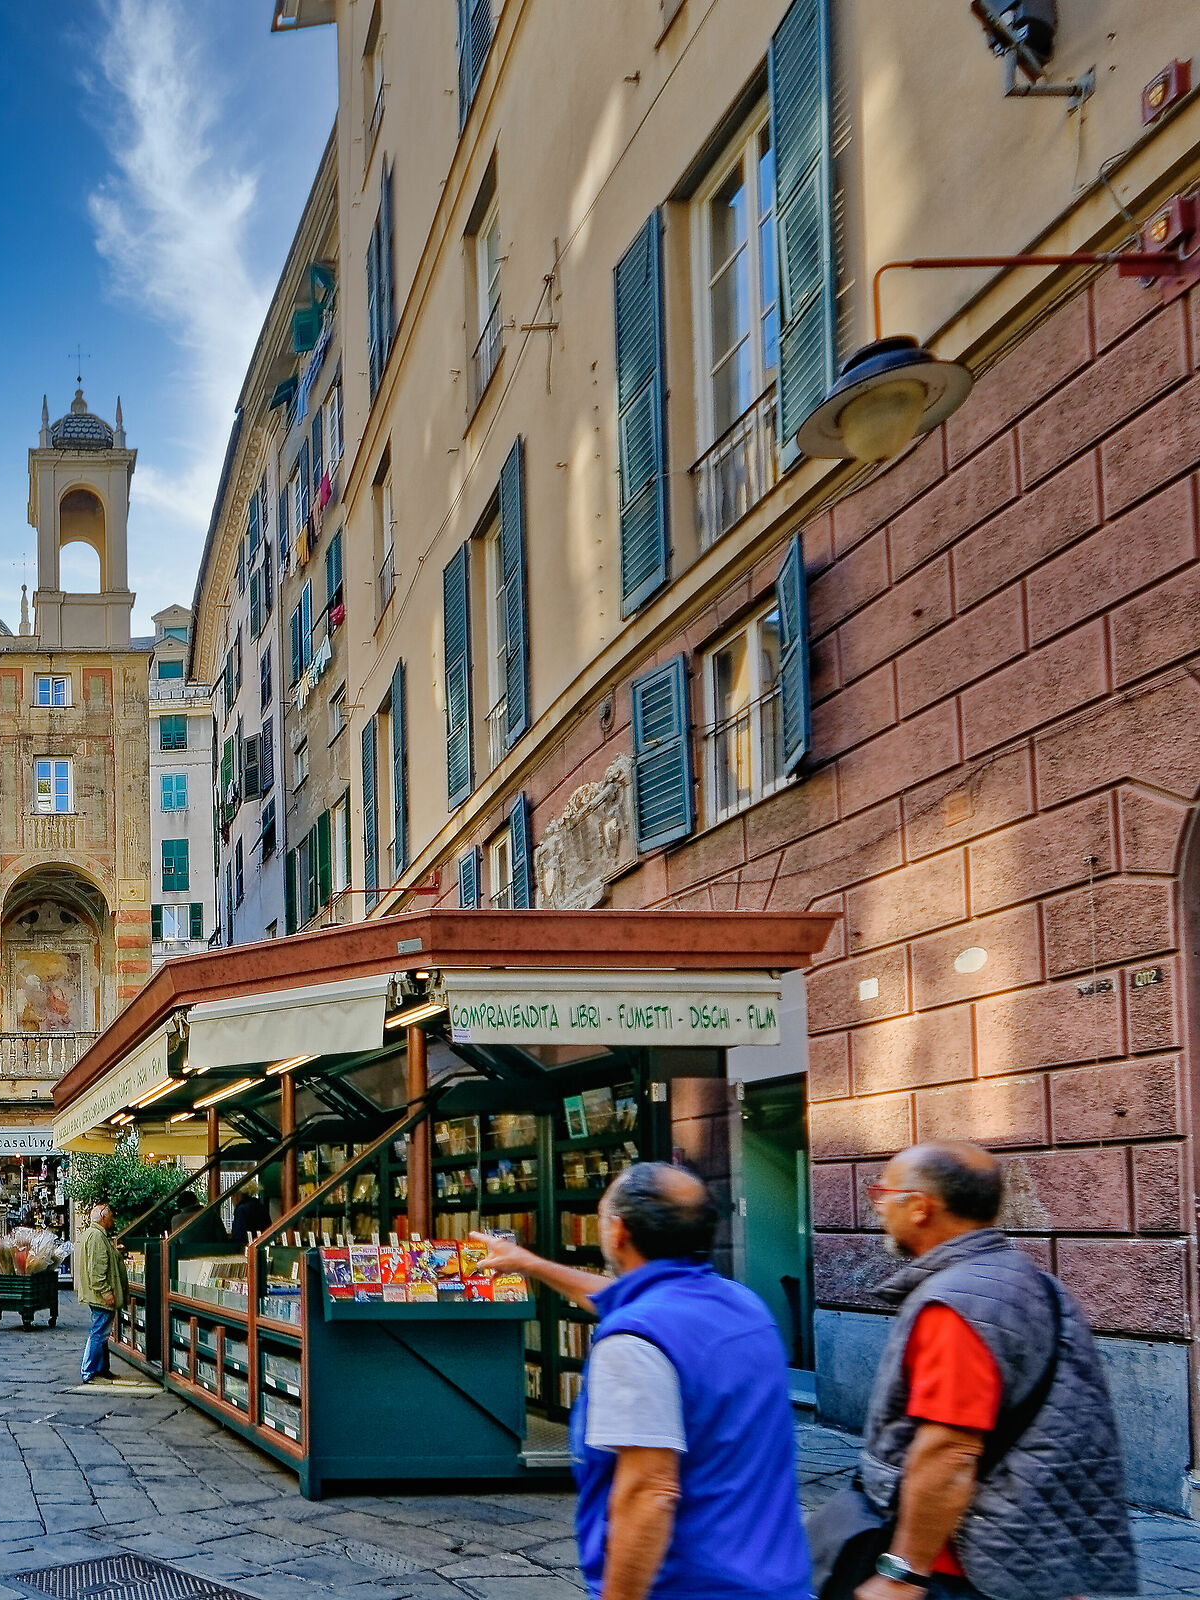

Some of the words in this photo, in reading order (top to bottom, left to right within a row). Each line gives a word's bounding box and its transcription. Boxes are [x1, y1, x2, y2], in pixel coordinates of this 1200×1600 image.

[452, 1002, 559, 1030] COMPRAVENDITA
[569, 1004, 601, 1029] LIBRI
[618, 1004, 673, 1029] FUMETTI
[689, 1005, 730, 1029] DISCHI
[747, 1004, 777, 1029] FILM
[496, 1276, 522, 1287] ZAGOR
